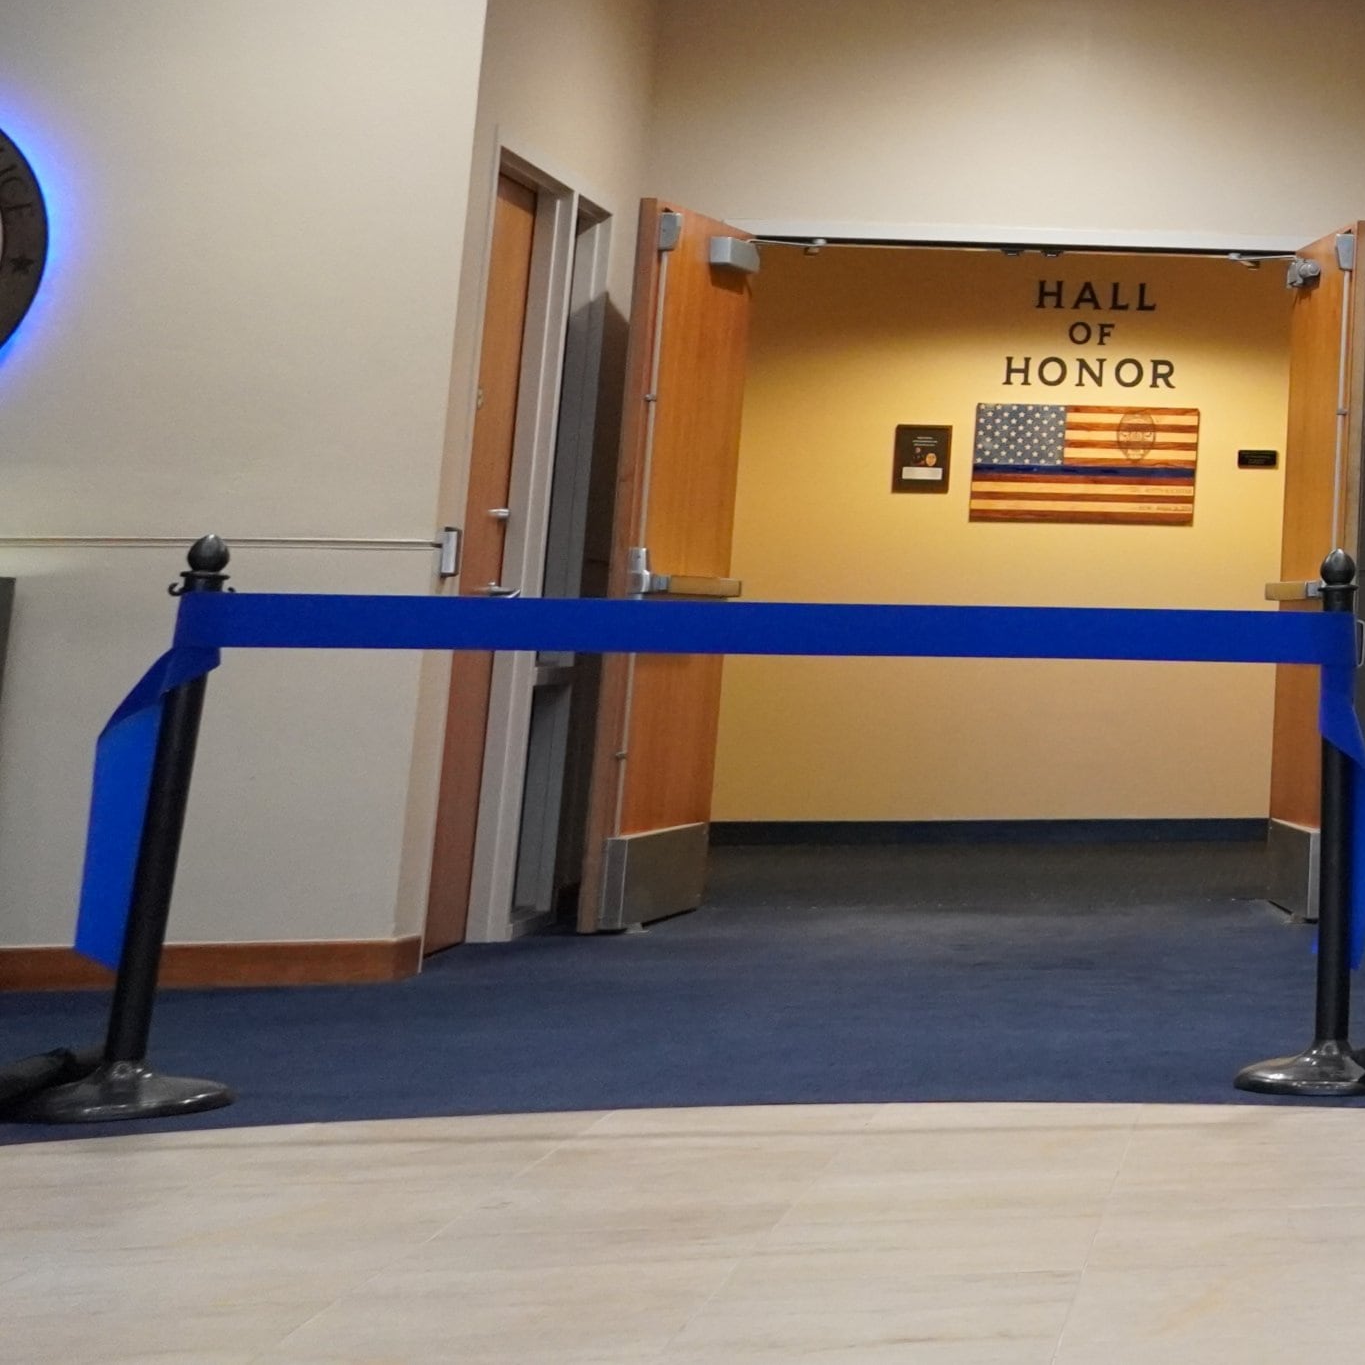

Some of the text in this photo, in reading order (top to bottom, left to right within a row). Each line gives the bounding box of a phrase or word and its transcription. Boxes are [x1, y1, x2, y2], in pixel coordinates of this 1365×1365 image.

[1035, 280, 1157, 312] HALL
[1068, 321, 1115, 346] OF
[1002, 356, 1176, 389] HONOR
